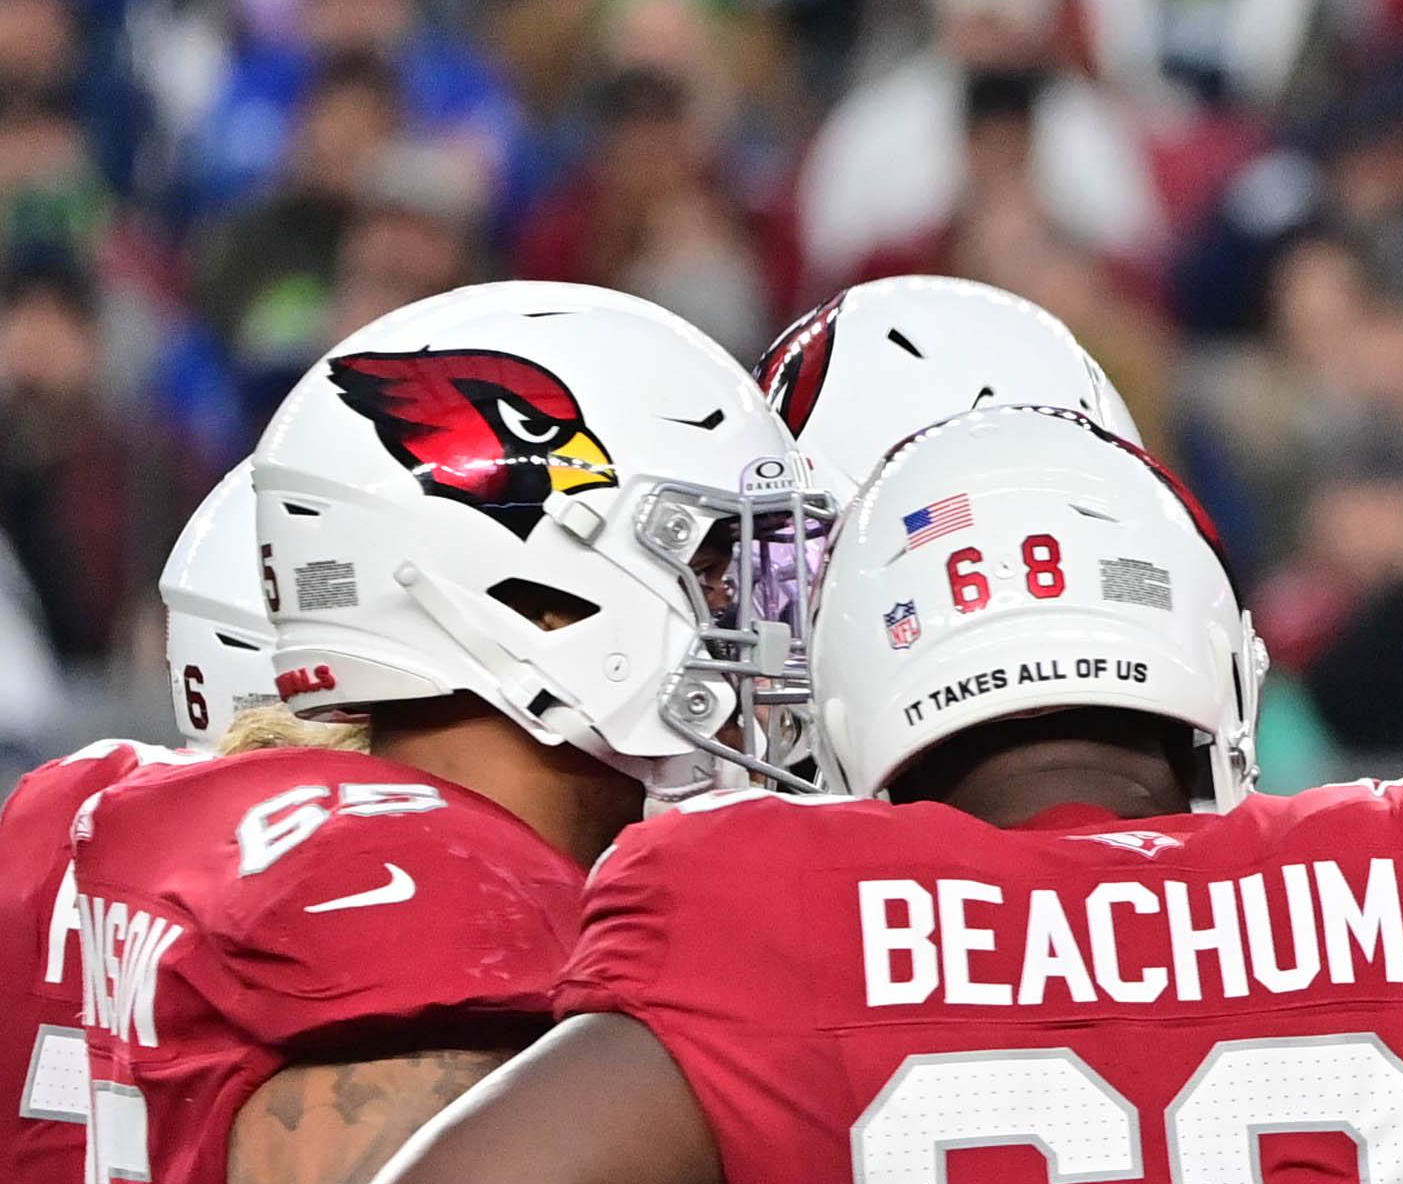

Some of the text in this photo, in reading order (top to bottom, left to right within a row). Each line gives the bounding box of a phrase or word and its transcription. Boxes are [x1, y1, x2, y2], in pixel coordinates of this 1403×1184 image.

[746, 480, 792, 491] OAKLEY
[889, 619, 922, 647] NFL
[183, 665, 209, 730] 6
[904, 659, 1149, 726] IT TAKES ALL OF US
[237, 782, 447, 876] 65
